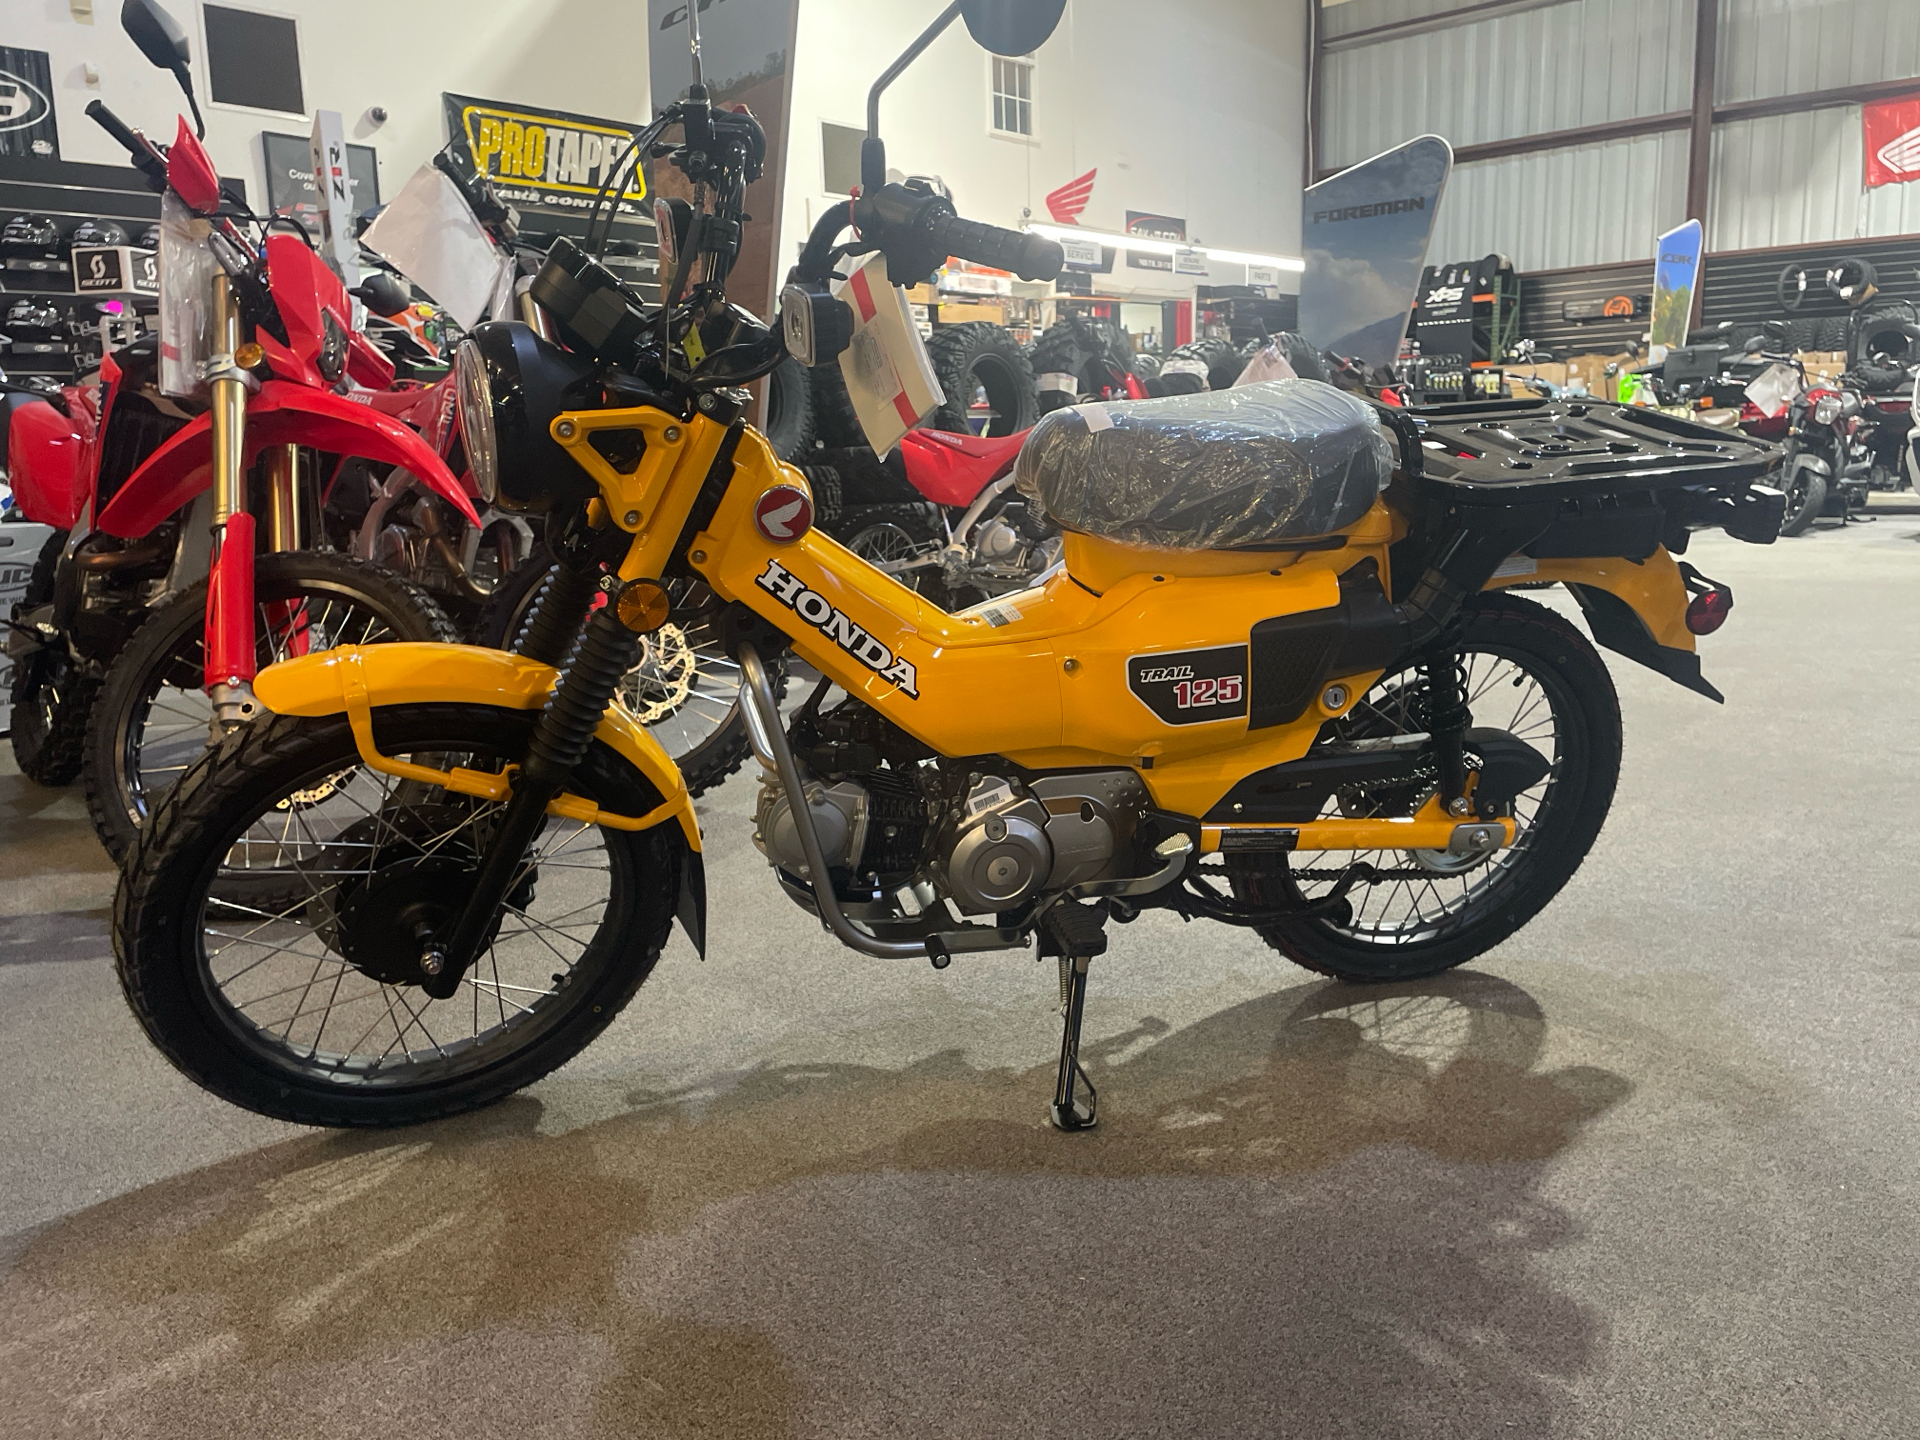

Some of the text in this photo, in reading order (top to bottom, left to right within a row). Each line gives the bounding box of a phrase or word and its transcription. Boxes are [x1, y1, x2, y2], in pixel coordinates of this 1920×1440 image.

[1313, 196, 1425, 224] FOREMAN
[80, 278, 119, 287] SCOTT
[1425, 286, 1465, 303] XPS
[930, 431, 963, 446] HONDA
[754, 558, 921, 701] HONDA
[1141, 666, 1194, 683] TRAIL
[1173, 675, 1243, 709] 125
